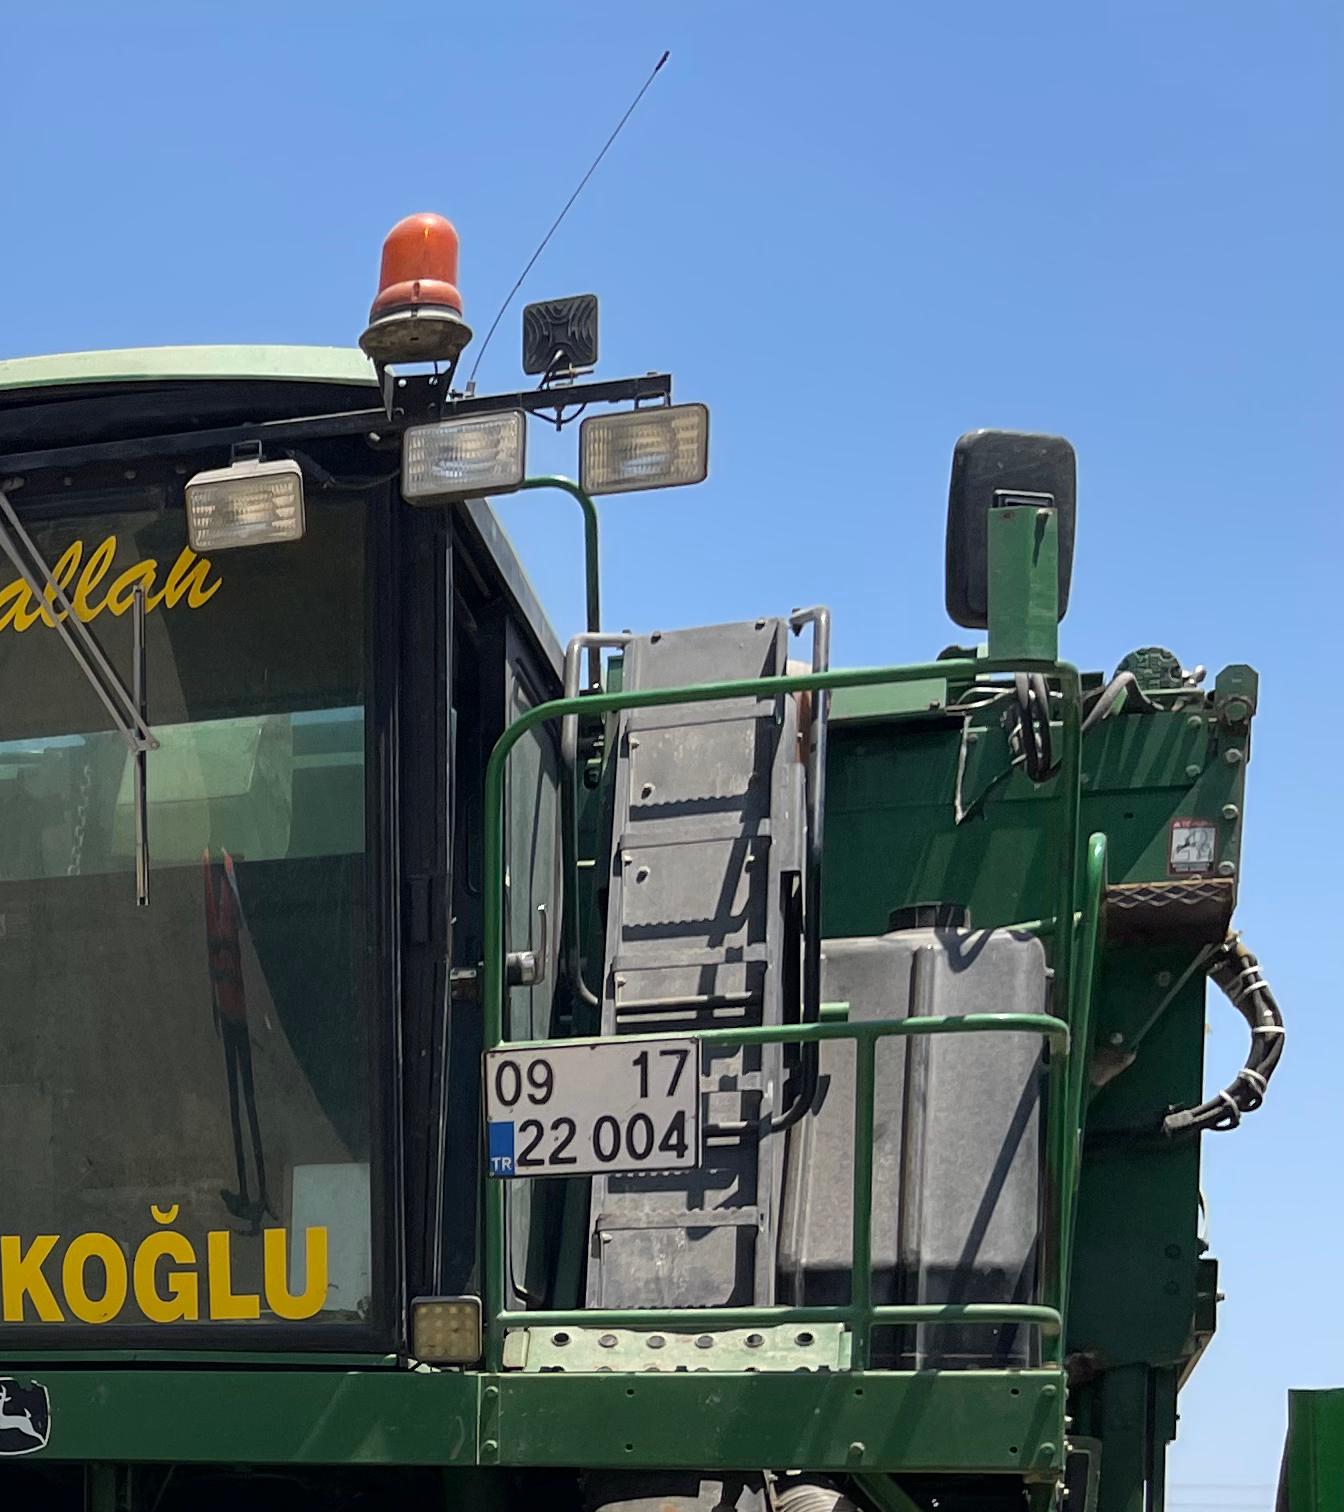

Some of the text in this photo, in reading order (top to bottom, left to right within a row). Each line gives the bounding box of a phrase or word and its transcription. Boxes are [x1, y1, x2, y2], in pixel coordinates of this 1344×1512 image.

[495, 1050, 690, 1106] 09 17
[491, 1157, 512, 1170] TR
[517, 1110, 688, 1166] 22 004
